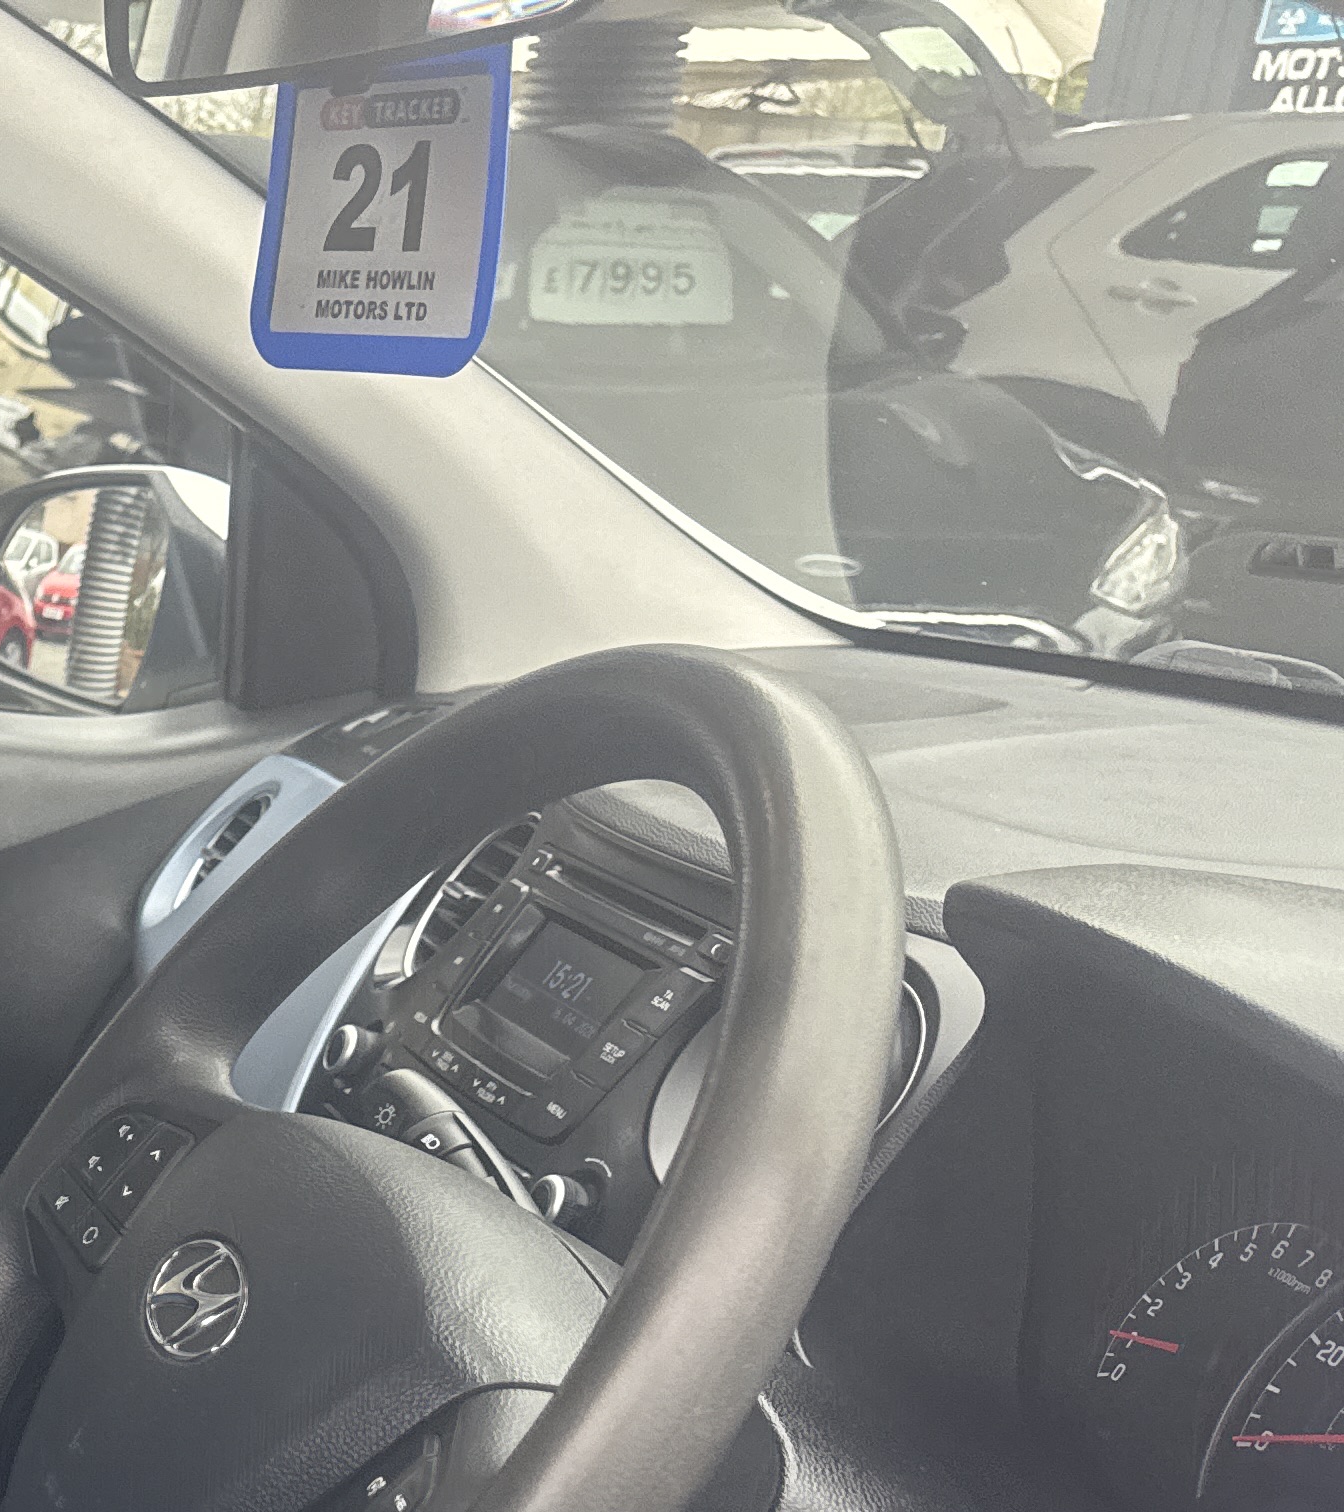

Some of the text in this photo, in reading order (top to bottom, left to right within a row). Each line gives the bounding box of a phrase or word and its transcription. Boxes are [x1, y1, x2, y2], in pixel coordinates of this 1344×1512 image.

[329, 97, 455, 127] KEY TRACKER
[322, 140, 432, 252] 21
[316, 269, 436, 291] MIKE HOWLIN
[314, 300, 429, 322] MOTORS LTD
[542, 960, 593, 1001] 15:21
[547, 1101, 568, 1119] MENU
[1239, 1242, 1257, 1262] 5
[1271, 1240, 1289, 1259] 6
[1297, 1250, 1315, 1268] 7
[1208, 1252, 1224, 1270] 4
[1175, 1271, 1192, 1290] 3
[1315, 1268, 1333, 1288] 8
[1147, 1299, 1163, 1317] 2
[1316, 1340, 1344, 1367] 20
[1111, 1364, 1126, 1381] 0
